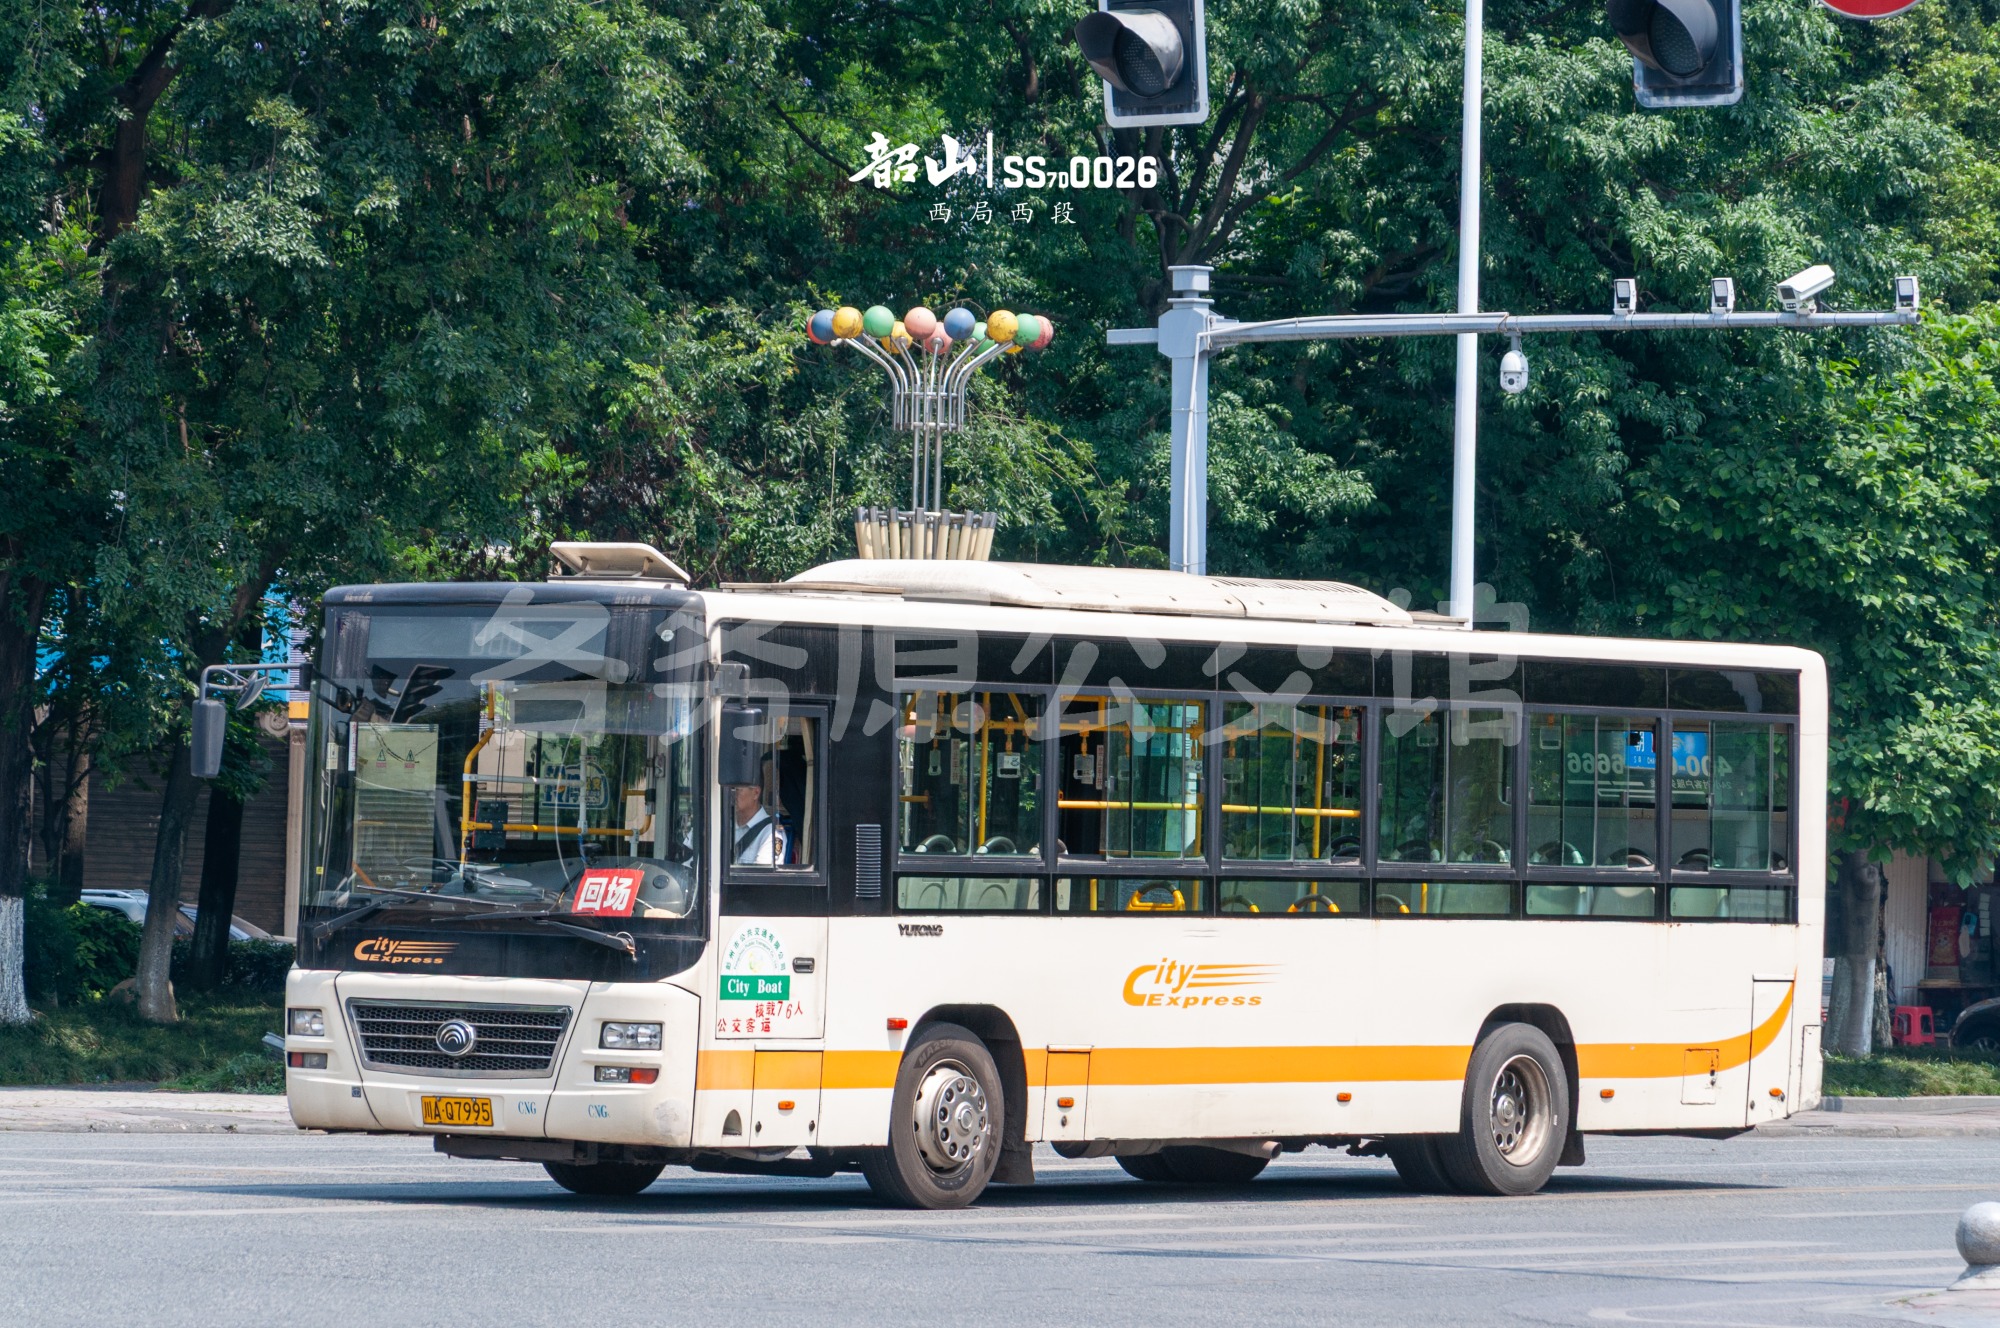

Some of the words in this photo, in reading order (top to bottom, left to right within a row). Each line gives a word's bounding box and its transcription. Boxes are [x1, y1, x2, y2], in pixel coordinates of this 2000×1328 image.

[577, 876, 634, 911] 回场
[898, 924, 943, 936] YUTONG
[354, 937, 399, 961] City
[369, 954, 444, 964] Express
[727, 979, 750, 997] City
[757, 979, 782, 994] Boat
[1123, 958, 1195, 1007] City
[1146, 994, 1262, 1009] Express
[755, 1000, 803, 1019] 核载76人
[717, 1018, 771, 1032] 公交客运
[518, 1101, 536, 1115] CNG
[588, 1104, 608, 1118] CNG
